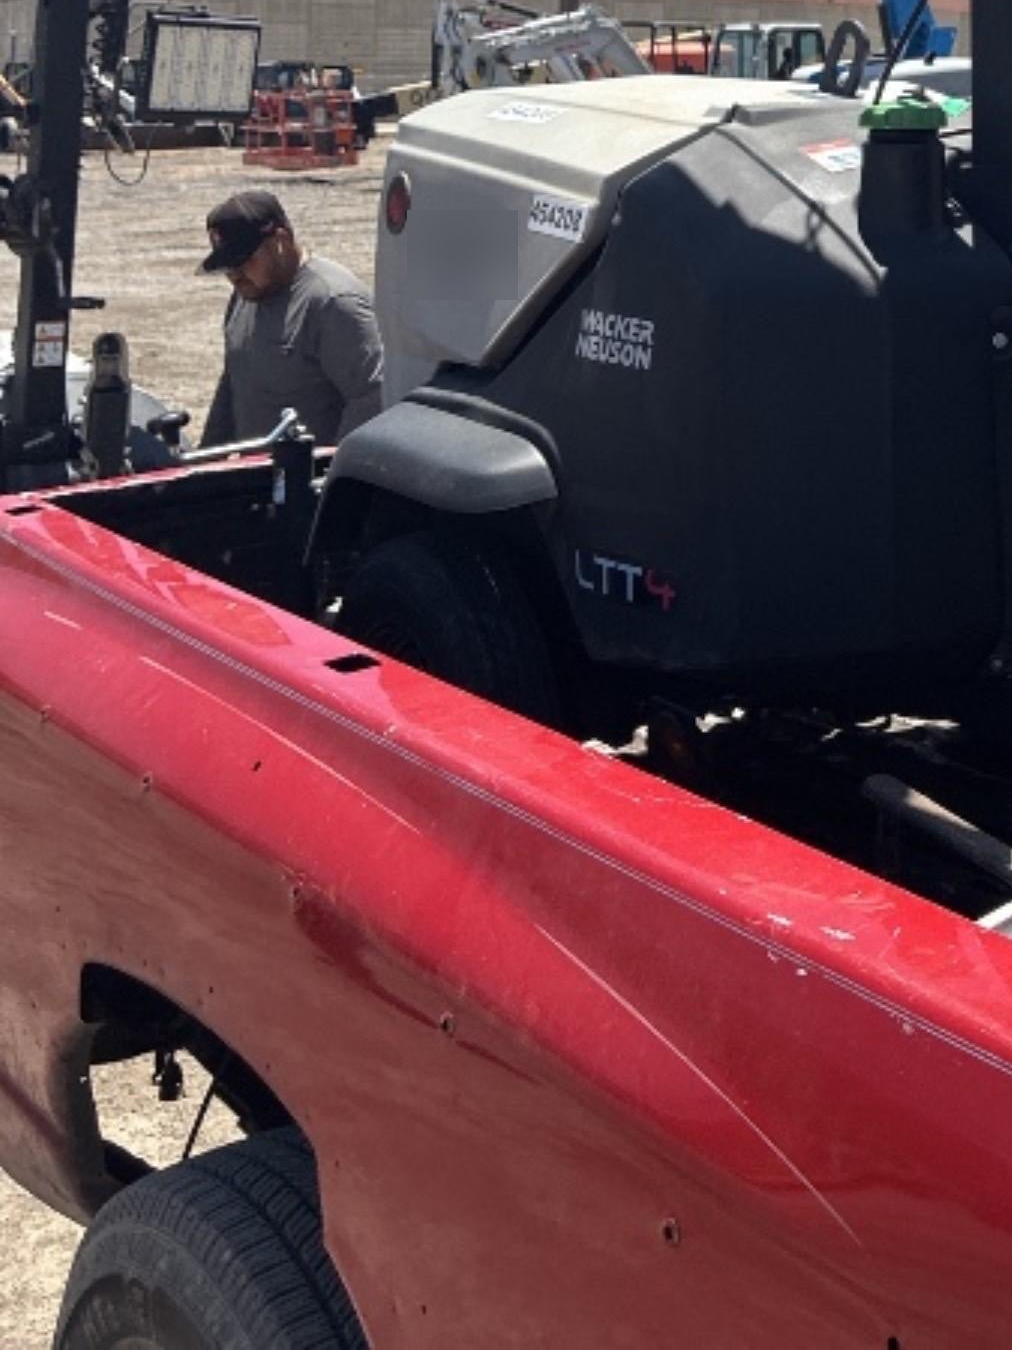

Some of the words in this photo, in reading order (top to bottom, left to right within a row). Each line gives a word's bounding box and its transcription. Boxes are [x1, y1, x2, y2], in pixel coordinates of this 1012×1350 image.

[581, 309, 654, 346] WACKER
[575, 332, 652, 370] NEUSON
[575, 549, 676, 611] LTT4
